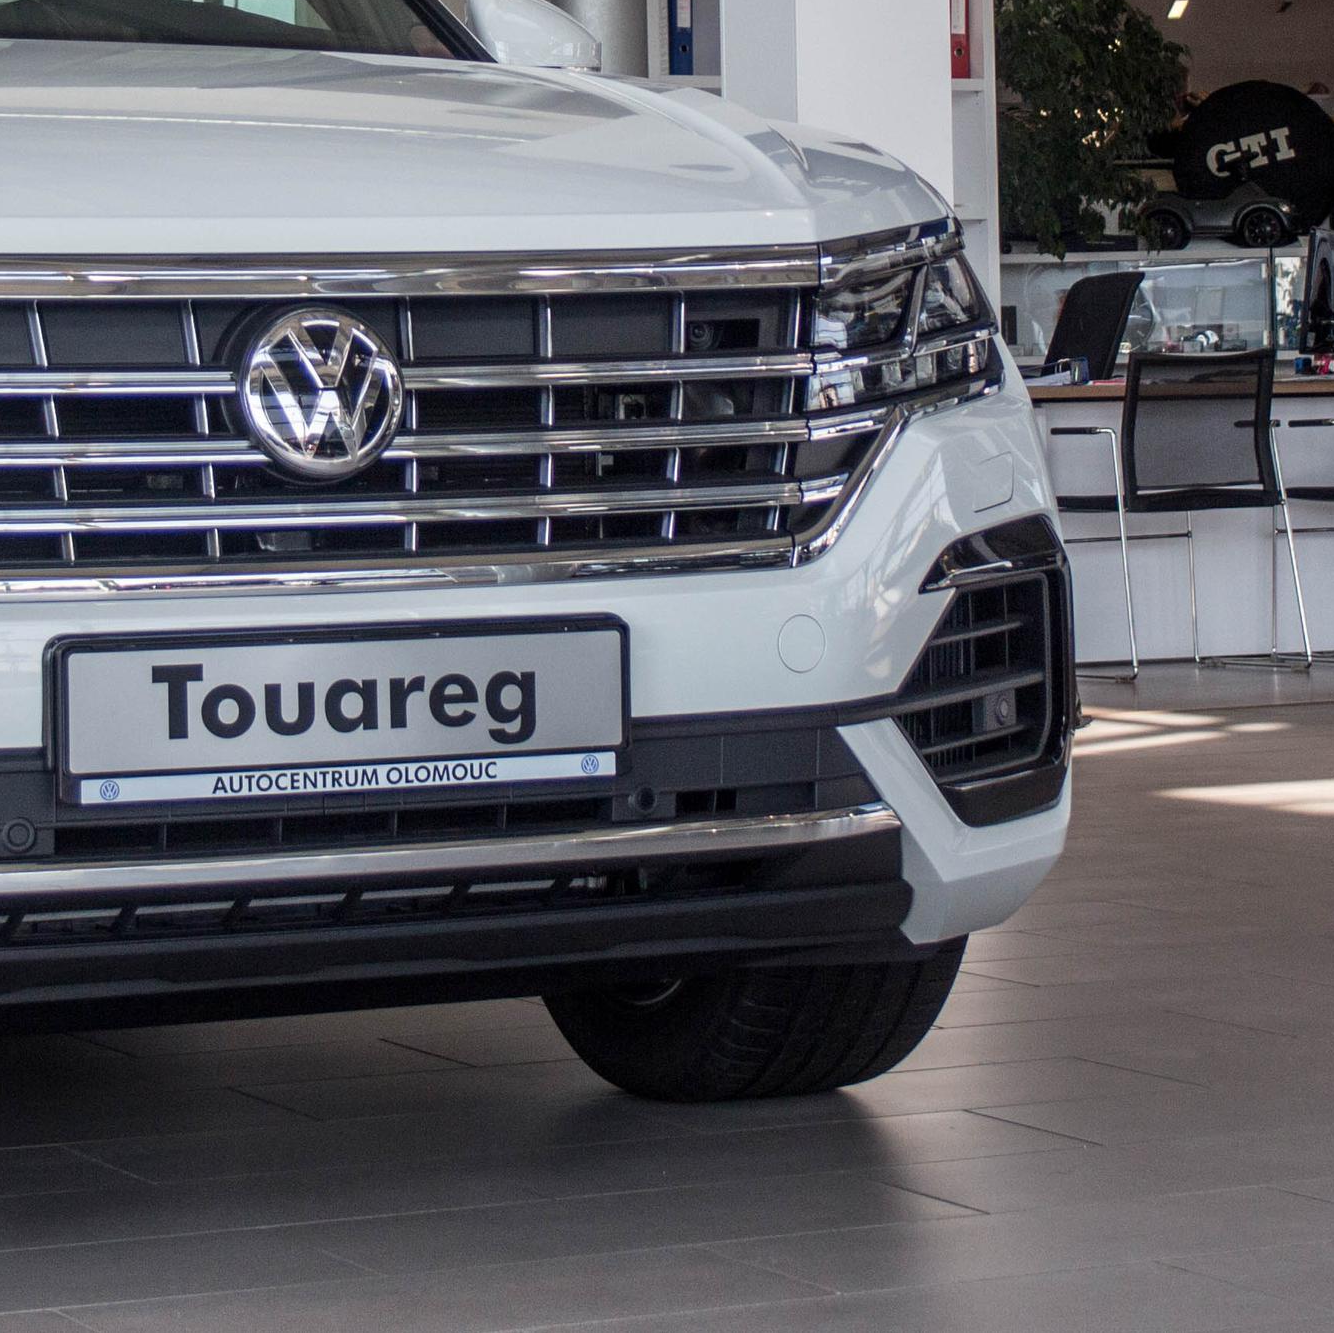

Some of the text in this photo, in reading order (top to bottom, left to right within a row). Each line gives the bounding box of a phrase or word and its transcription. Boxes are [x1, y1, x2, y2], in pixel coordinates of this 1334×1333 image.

[1206, 127, 1296, 177] GTI
[151, 663, 536, 744] Touareg
[211, 768, 380, 795] AUTOCENTRUM
[386, 760, 498, 784] OLOMOUC
